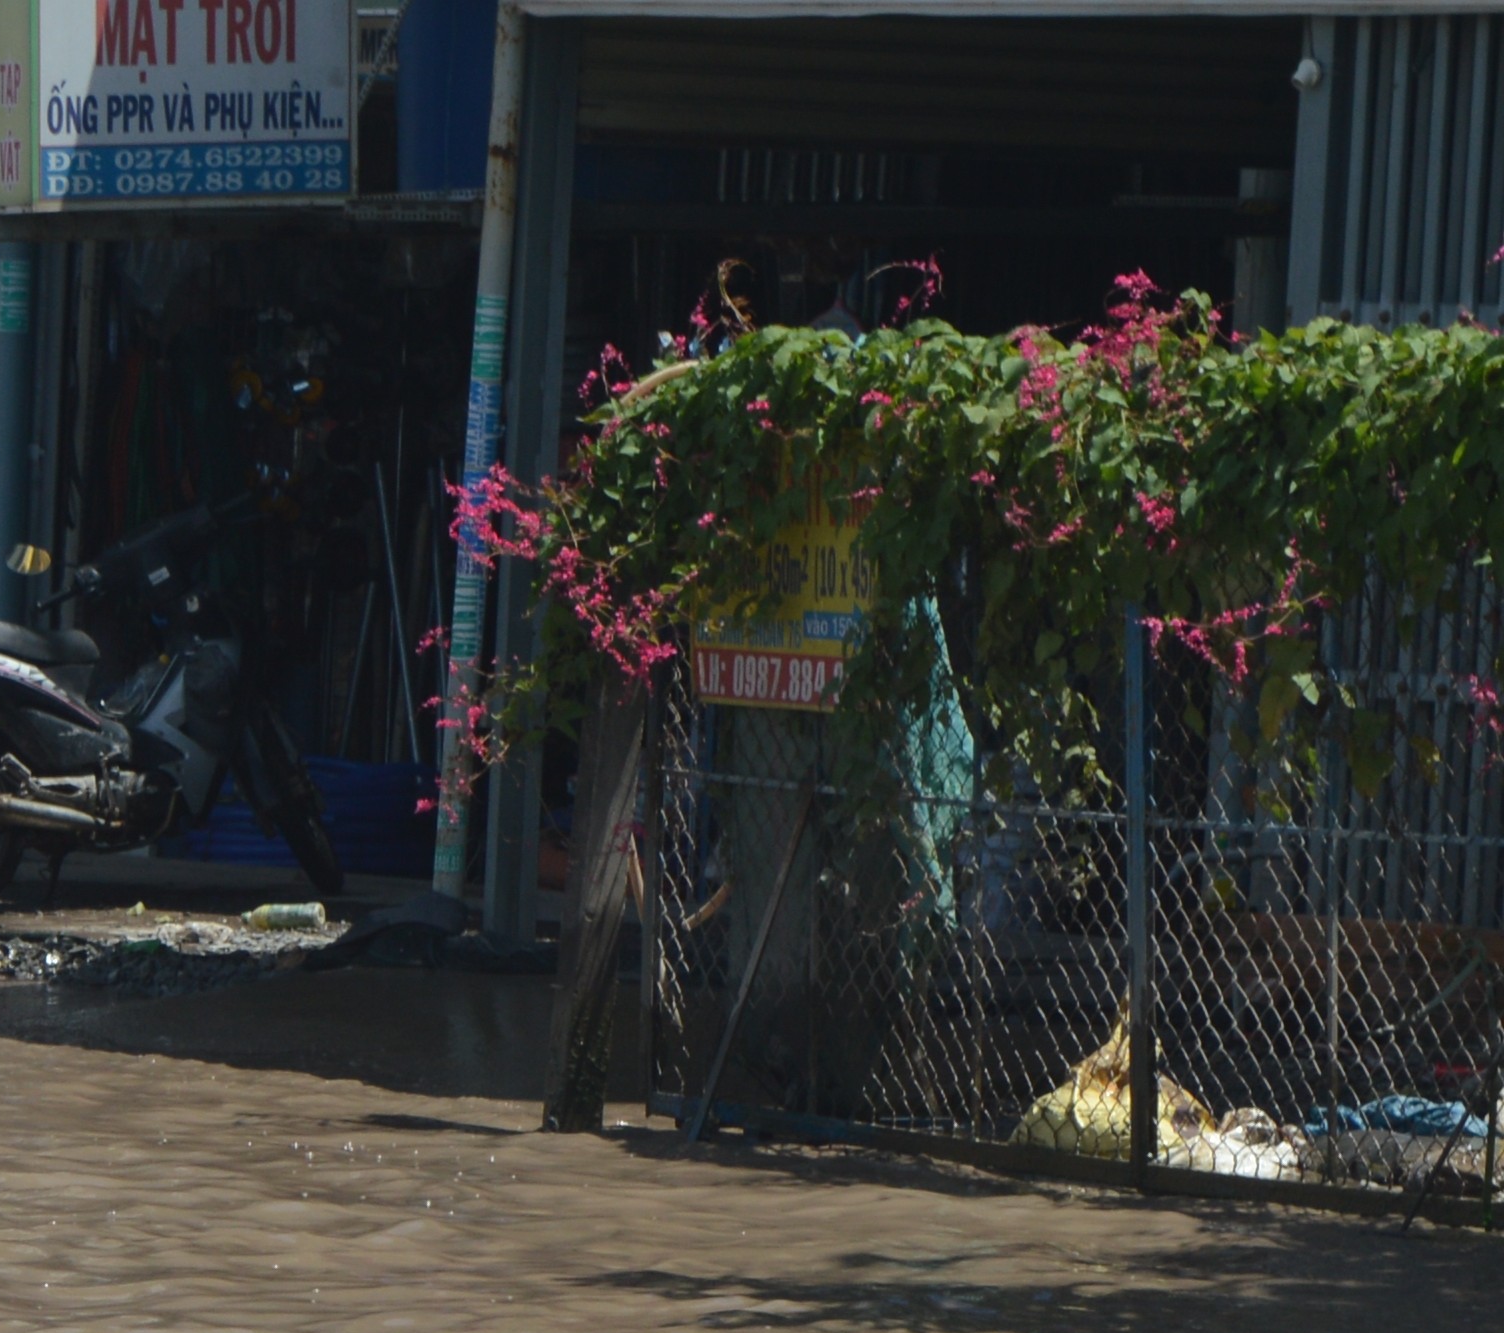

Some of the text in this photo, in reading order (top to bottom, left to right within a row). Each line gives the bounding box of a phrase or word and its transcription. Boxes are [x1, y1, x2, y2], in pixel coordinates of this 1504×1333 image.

[47, 80, 99, 135] ỐNG
[106, 94, 154, 135] PPR
[162, 82, 195, 133] VÀ
[204, 91, 253, 139] PHỤ
[114, 144, 344, 170] 0274.6522399
[254, 170, 293, 191] 40
[304, 168, 343, 189] 28
